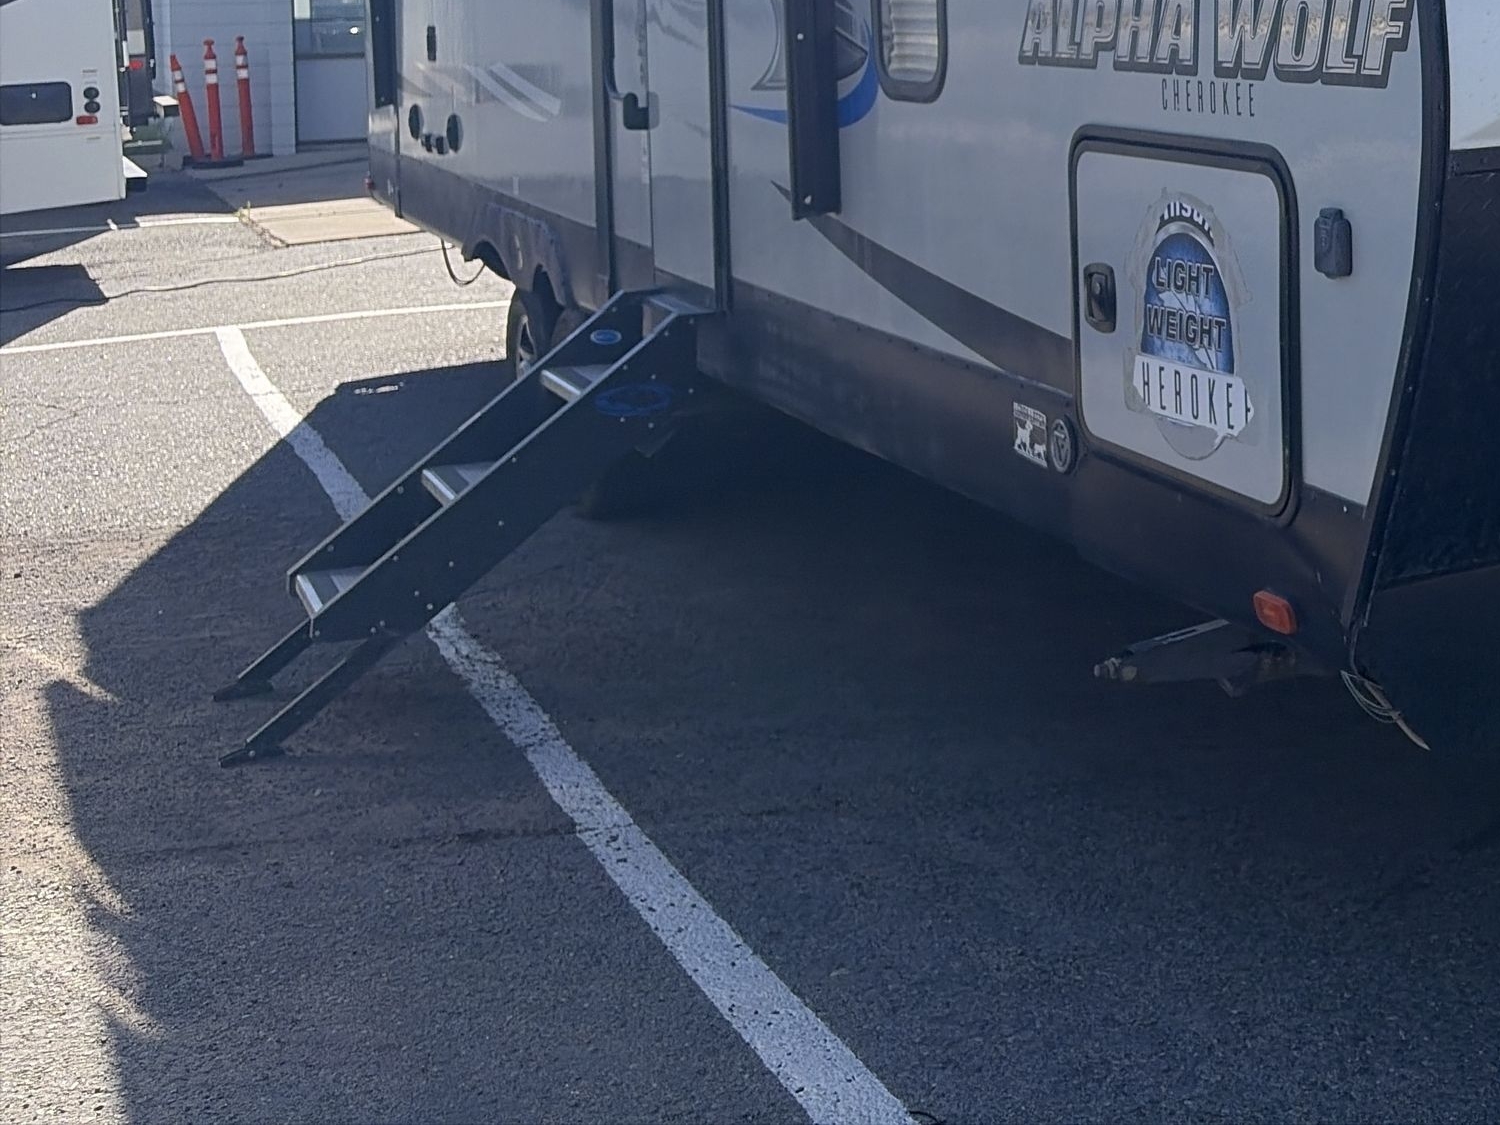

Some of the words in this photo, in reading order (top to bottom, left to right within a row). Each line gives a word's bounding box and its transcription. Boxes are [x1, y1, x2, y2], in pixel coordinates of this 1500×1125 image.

[1161, 78, 1255, 117] CHEROKEE
[1153, 257, 1214, 296] LIGHT
[1147, 303, 1226, 353] WEIGHT
